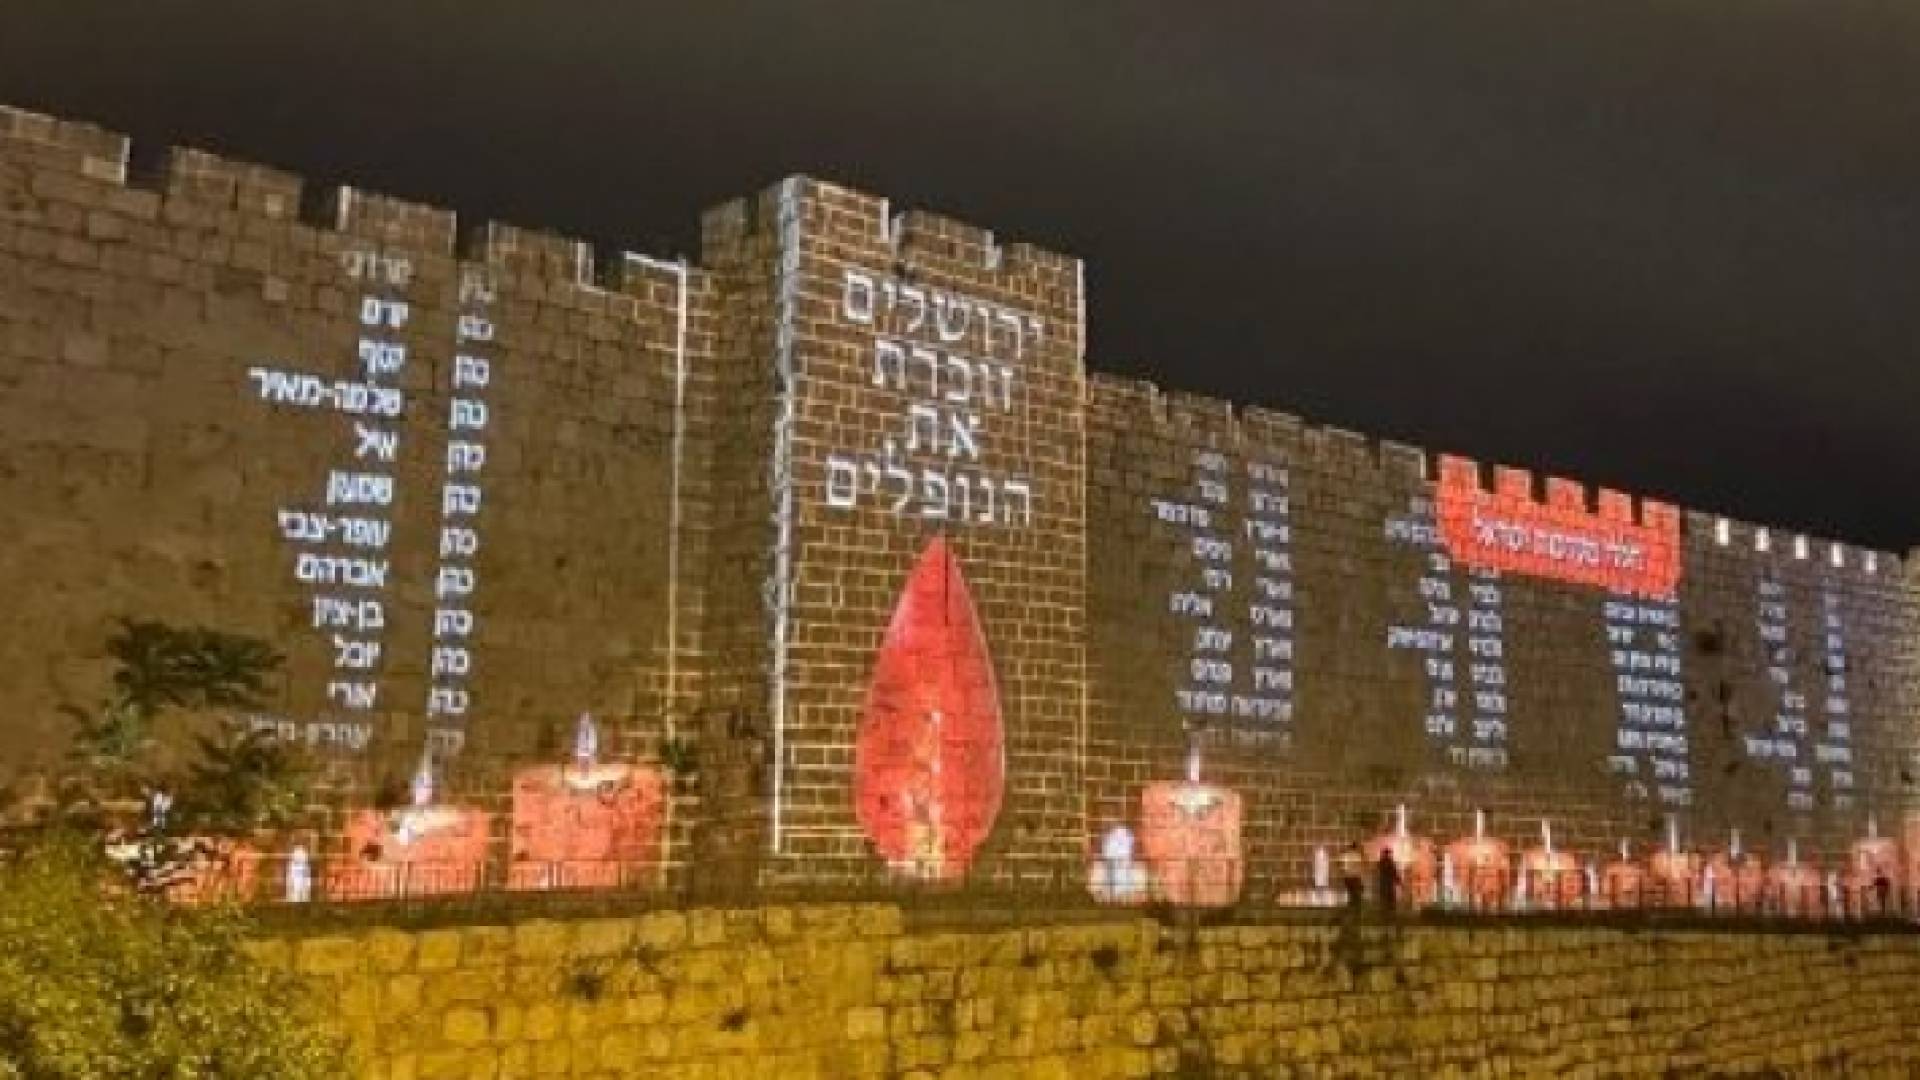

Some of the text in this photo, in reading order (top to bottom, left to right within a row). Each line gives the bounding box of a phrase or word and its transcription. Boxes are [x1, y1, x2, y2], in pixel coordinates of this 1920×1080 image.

[843, 270, 1043, 361] ירושלים
[455, 355, 489, 388] כהן
[872, 336, 1013, 413] זוכרת
[451, 397, 487, 430] כהן
[906, 404, 981, 460] את
[448, 441, 486, 473] כהן
[444, 484, 481, 517] כהן
[826, 440, 1030, 528] הנופלים
[440, 526, 478, 558] כהן
[296, 552, 474, 600] כהן אברהם
[434, 609, 473, 639] כהן
[432, 647, 470, 678] כהן
[427, 687, 469, 719] כהן
